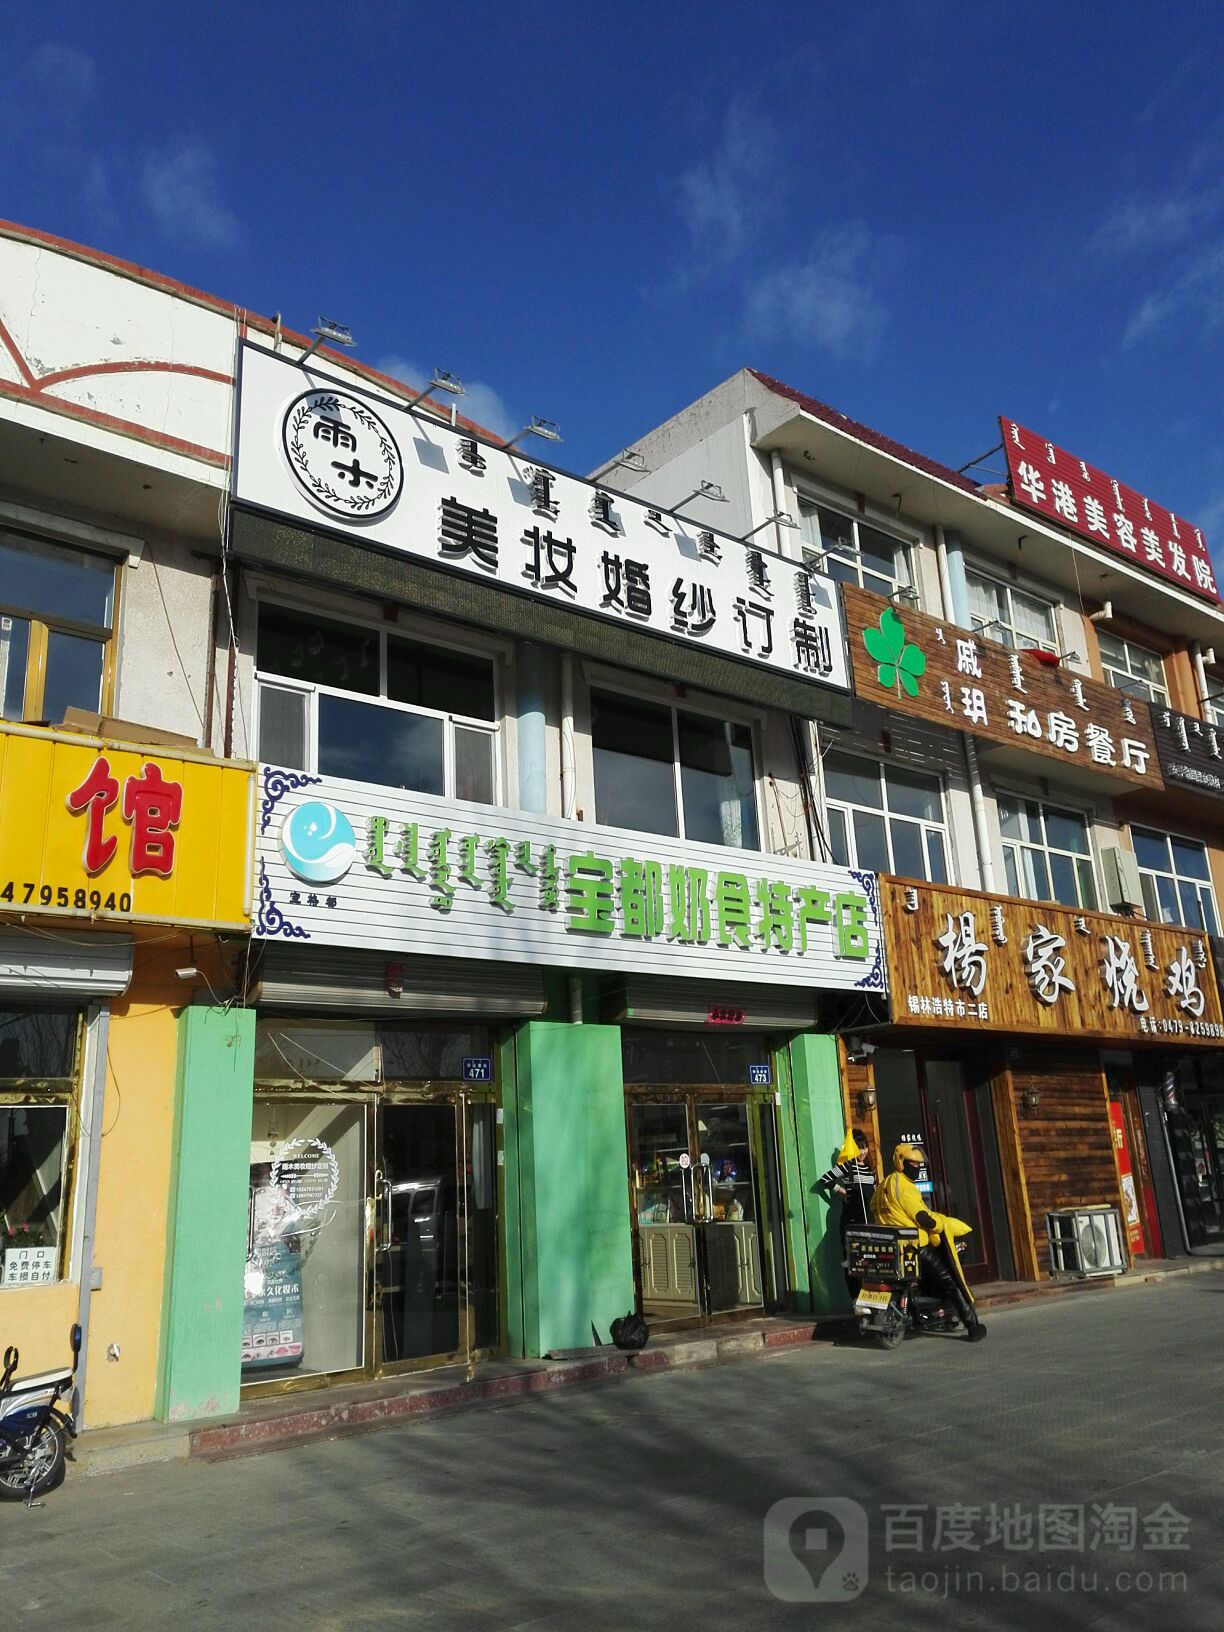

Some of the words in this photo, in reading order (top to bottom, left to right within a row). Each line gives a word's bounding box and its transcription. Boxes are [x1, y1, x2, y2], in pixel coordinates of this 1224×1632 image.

[1018, 460, 1217, 594] 华港美容美发院
[440, 496, 833, 675] 美妆婚纱订制
[1005, 699, 1150, 775] 私房餐厅
[66, 757, 183, 874] 馆
[1, 881, 131, 912] 47958940
[565, 850, 870, 959] 宝都奶食特产店
[907, 994, 988, 1020] 锡林浩特市二店
[468, 1068, 485, 1078] 471
[754, 1073, 767, 1082] 473
[9, 1261, 52, 1271] 免费停车
[19, 1251, 45, 1260] 门口
[8, 1271, 51, 1281] 车损自付
